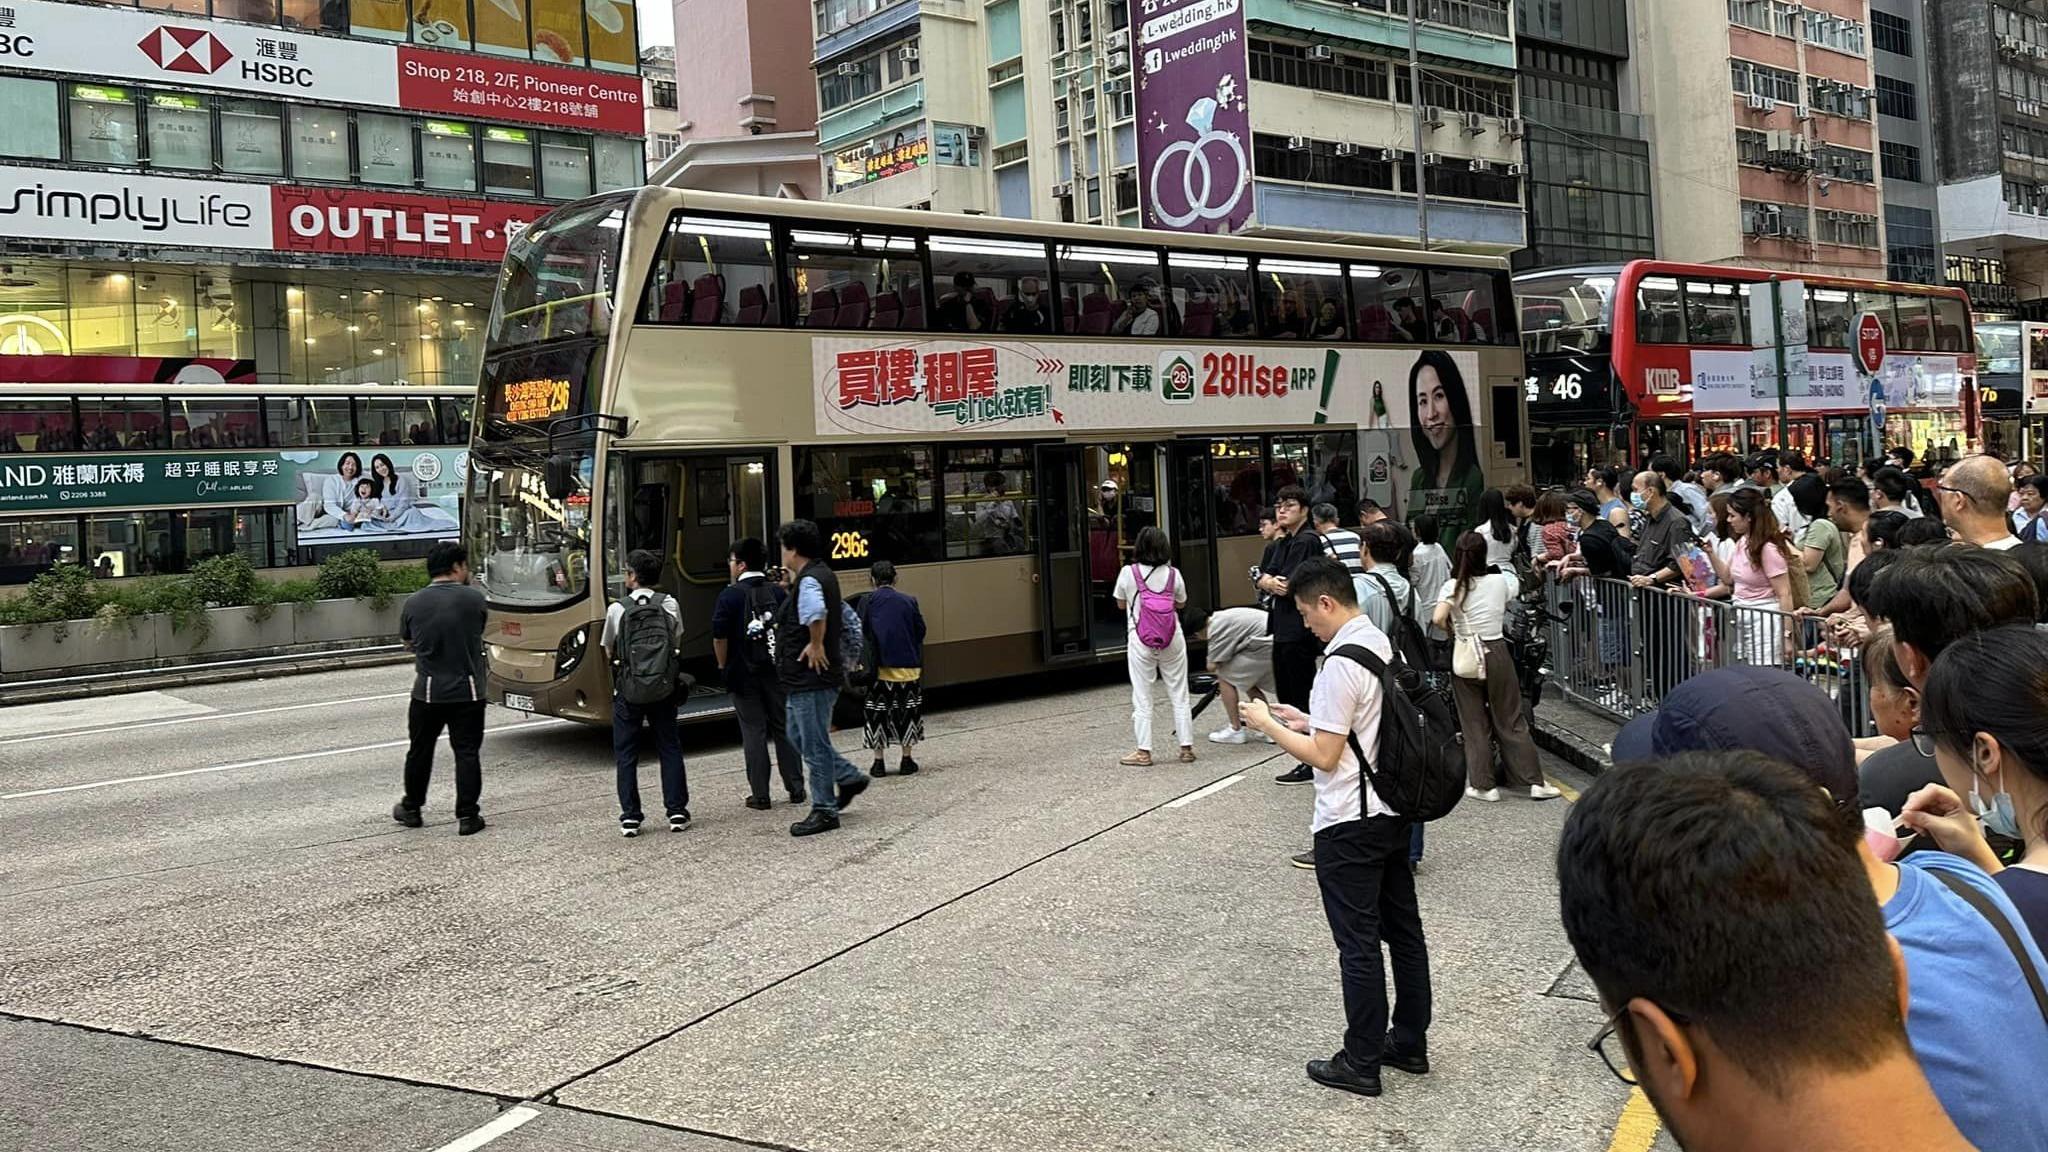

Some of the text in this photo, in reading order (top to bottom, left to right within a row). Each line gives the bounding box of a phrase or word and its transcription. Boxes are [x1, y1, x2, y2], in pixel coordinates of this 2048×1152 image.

[1147, 1, 1234, 38] L-wedding.hk
[1164, 28, 1237, 63] Lweddinghk
[241, 60, 314, 88] HSBC
[405, 60, 638, 104] Shop 218, 2/F, Pioneer Centre
[290, 203, 480, 245] OUTLET
[1861, 327, 1880, 340] STOP
[1068, 364, 1153, 393] 即刻下載
[1202, 351, 1289, 398] 28Hse
[1290, 367, 1317, 390] APP
[1173, 369, 1188, 385] 28
[1552, 373, 1583, 400] 46
[1645, 367, 1681, 395] KMB
[1980, 387, 1998, 402] 7D
[0, 465, 47, 488] ND
[52, 463, 145, 486] 雅蘭床褥
[165, 460, 279, 478] 超乎睡眠享受
